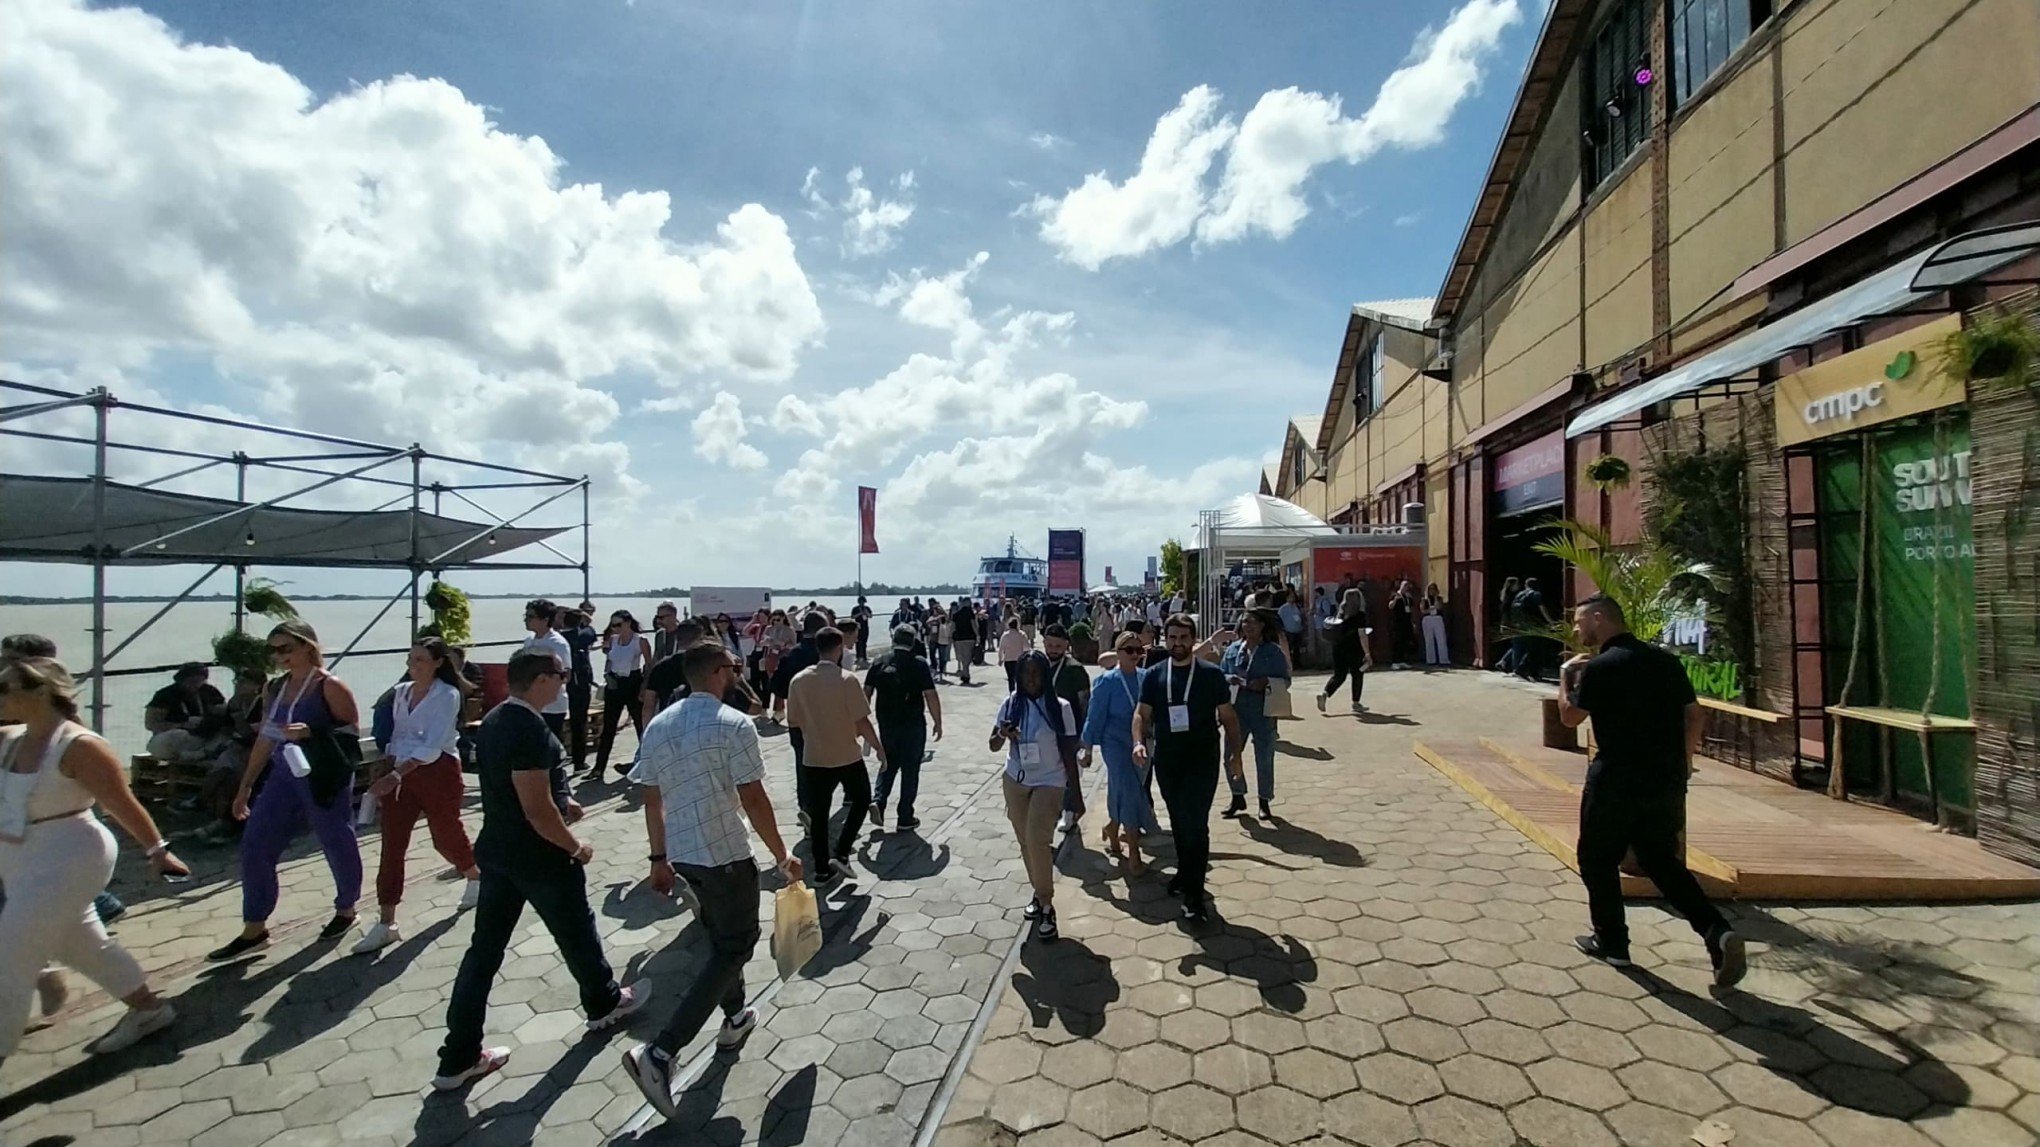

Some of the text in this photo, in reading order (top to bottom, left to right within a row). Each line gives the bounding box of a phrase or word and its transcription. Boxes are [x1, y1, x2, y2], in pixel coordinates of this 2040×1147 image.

[1804, 382, 1884, 424] cmpc
[1499, 446, 1563, 483] MARKETPLAC
[1893, 451, 1973, 486] SOUT
[1905, 544, 1955, 561] PORO
